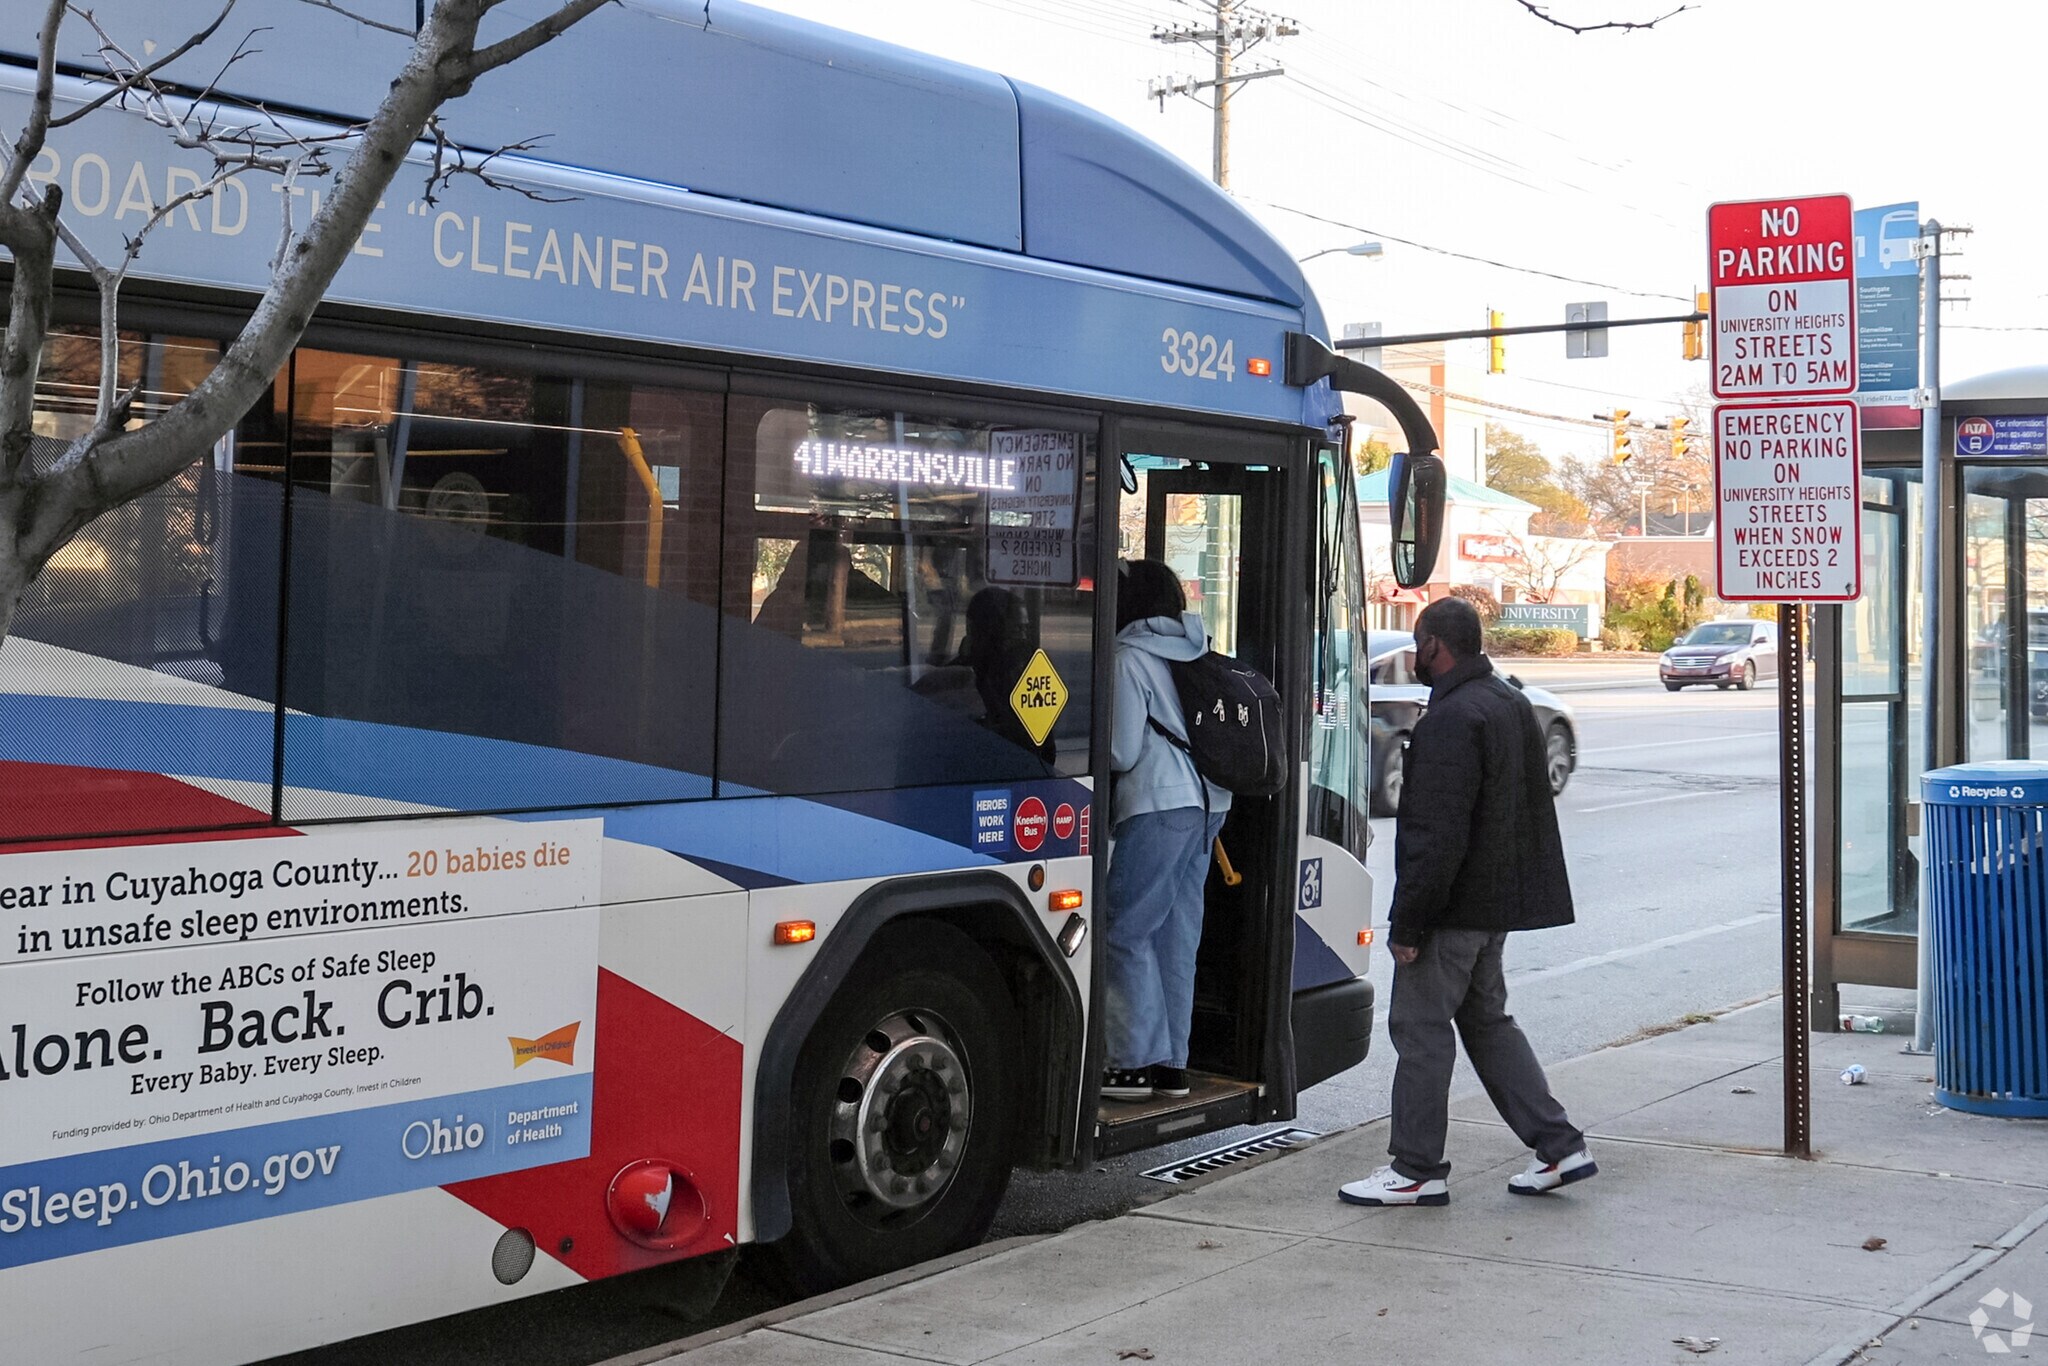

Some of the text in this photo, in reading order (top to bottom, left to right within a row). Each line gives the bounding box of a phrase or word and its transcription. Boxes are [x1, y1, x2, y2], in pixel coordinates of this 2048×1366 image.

[1761, 206, 1799, 238] NO
[1718, 241, 1845, 279] PARKING
[682, 252, 756, 312] AIR
[1768, 289, 1797, 313] ON
[1721, 313, 1845, 334] UNIVERSITY HEIGHTS
[1161, 327, 1236, 382] 3324
[1735, 333, 1832, 360] STREETS
[1721, 360, 1847, 387] 2AM TO 5AM
[1725, 412, 1845, 436] EMERGENCY
[1725, 437, 1847, 460] NO PARKING
[793, 441, 1015, 490] 41 WARRENSVILLE
[1774, 463, 1800, 483] ON
[1724, 486, 1851, 502] UNIVERSITY HEIGHTS
[1749, 504, 1827, 523] STREETS
[1734, 526, 1842, 545] WHEN SNOW
[1739, 548, 1838, 567] EXCEEDS 2
[1756, 571, 1821, 589] INCHES
[1500, 607, 1579, 619] UNIVERSITY
[1026, 676, 1051, 691] SAFE
[1962, 786, 2007, 799] Recycle
[976, 799, 1008, 811] HEROES
[979, 815, 1004, 827] WORK
[1016, 815, 1047, 826] Kneeling
[1056, 816, 1073, 824] RAMP
[978, 831, 1004, 843] HERE
[1024, 827, 1038, 836] Bus
[62, 876, 95, 904] in
[106, 867, 263, 905] Cuyahoga
[273, 857, 398, 888] County...
[407, 850, 438, 877] 20
[446, 846, 526, 875] babies
[533, 842, 570, 867] die
[18, 891, 468, 953] in unsafe sleep environments.
[75, 950, 436, 1007] Follow the ABCs of Safe Sleep
[0, 972, 494, 1081] lone. Back. Crib.
[516, 1043, 537, 1055] Invest
[537, 1042, 544, 1052] in
[130, 1044, 385, 1095] Every Baby. Every Sleep.
[52, 1076, 422, 1140] Funding provided by: Ohio Department of Health and Cuyahoga County, Invest in Children
[402, 1101, 579, 1160] Ohio Department
[507, 1123, 562, 1145] of Health
[1383, 1180, 1397, 1188] FILA
